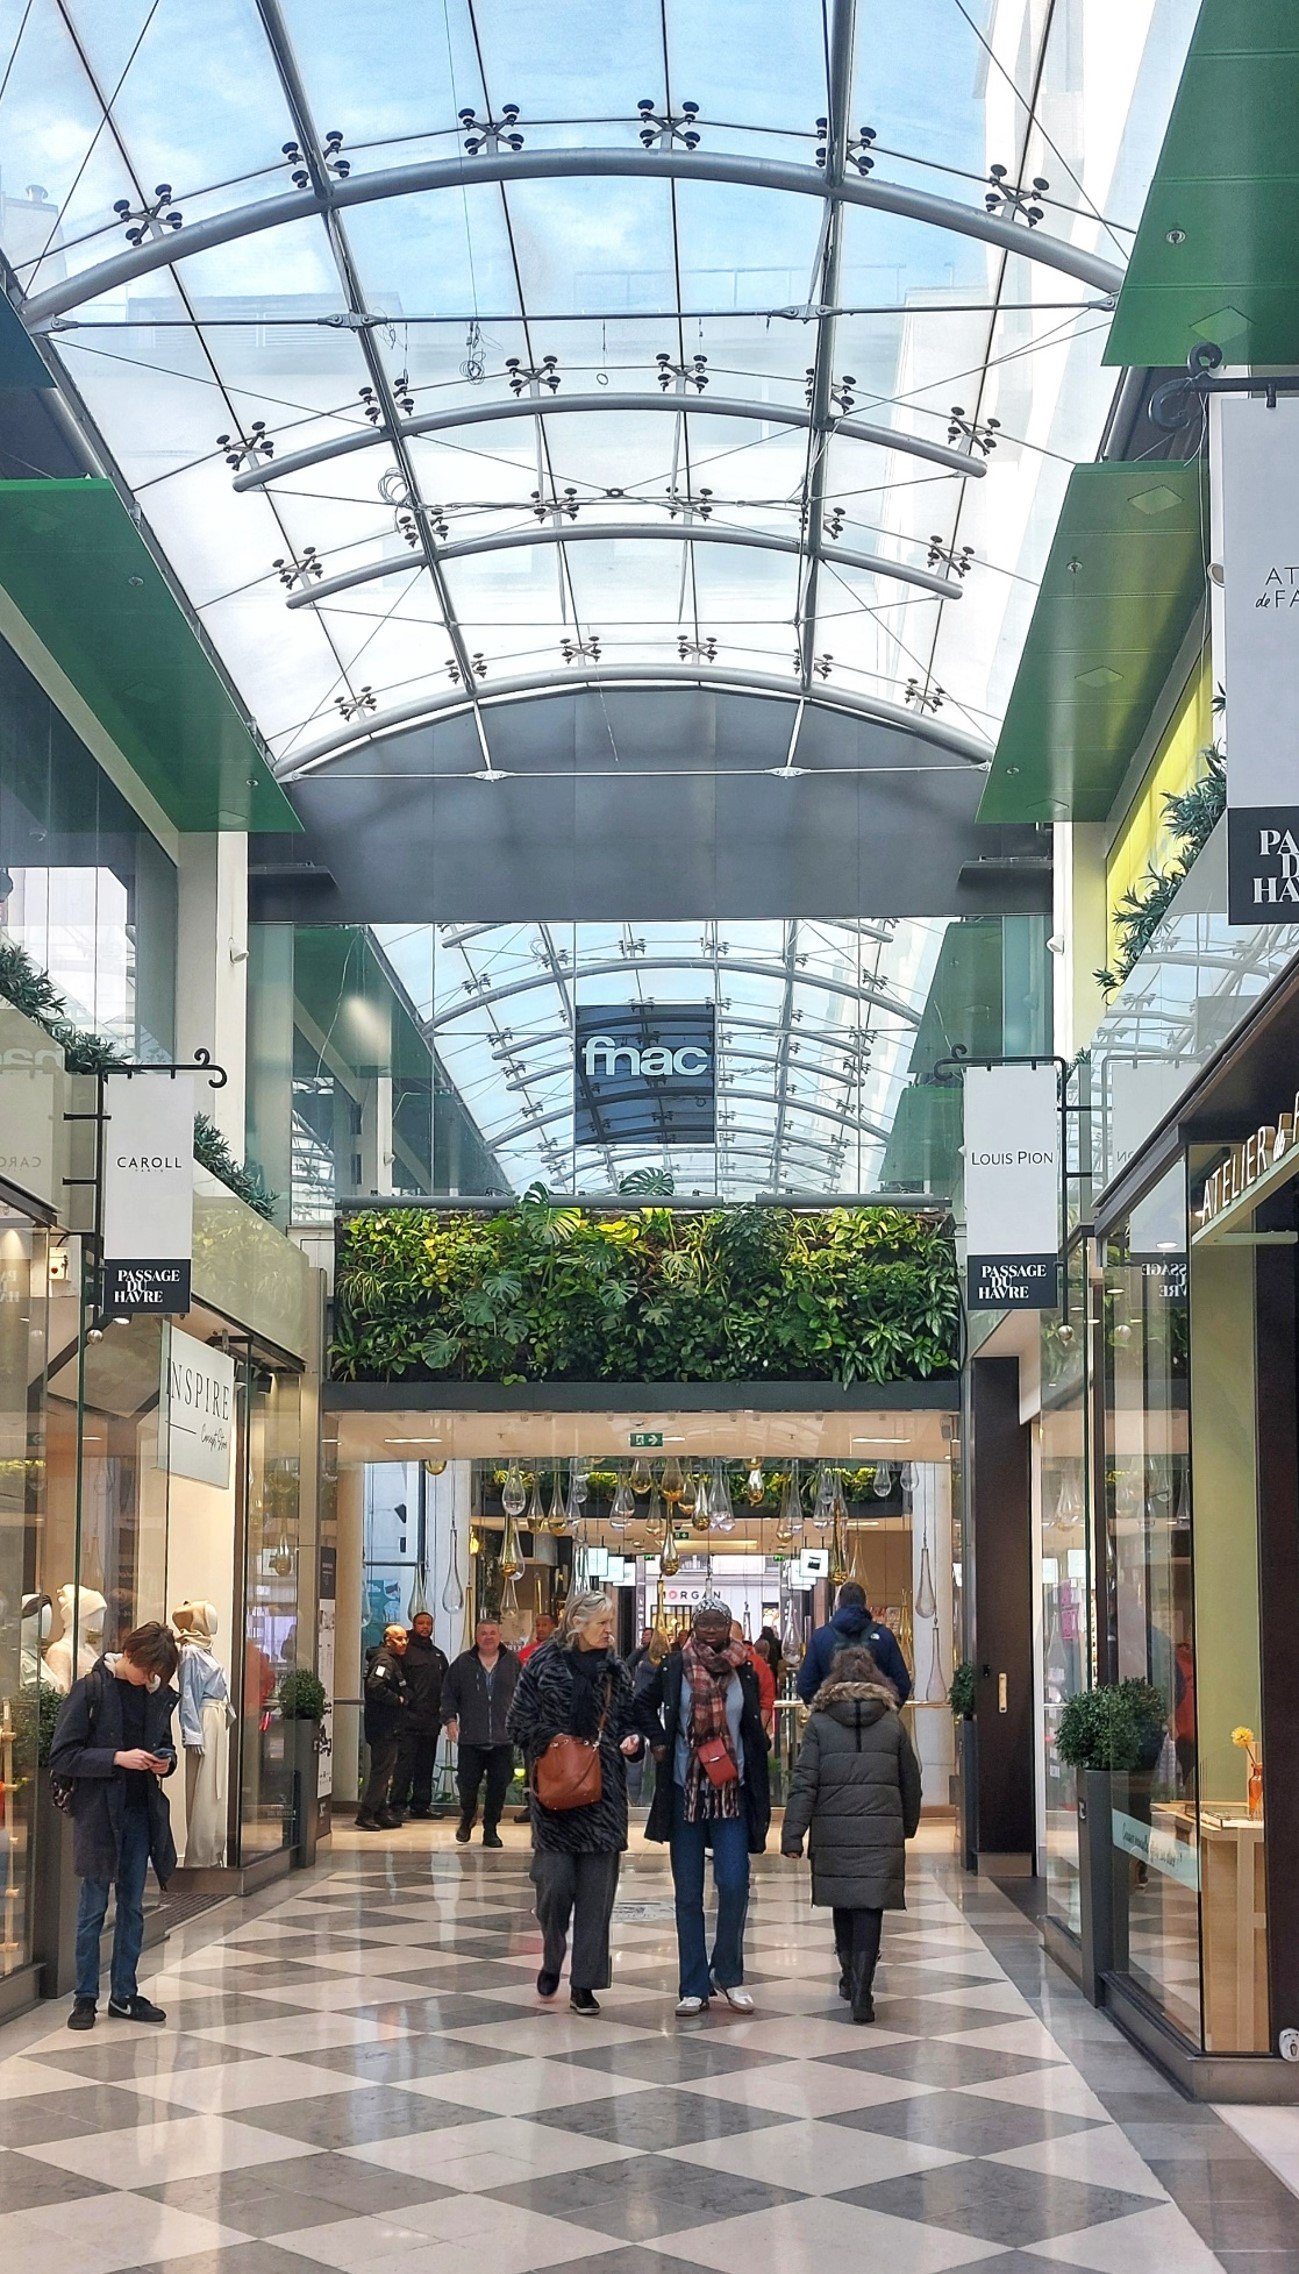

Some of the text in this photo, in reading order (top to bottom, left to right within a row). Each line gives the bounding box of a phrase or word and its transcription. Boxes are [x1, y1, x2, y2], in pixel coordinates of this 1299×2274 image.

[582, 1036, 708, 1076] fnac
[117, 1157, 182, 1168] CAROLL
[971, 1151, 1053, 1165] LOUIS PION
[1201, 1126, 1275, 1226] ATELIER
[117, 1269, 181, 1282] PASSAGE
[981, 1264, 1047, 1278] PASSAGE
[127, 1280, 148, 1292] DU
[991, 1275, 1012, 1289] DU
[114, 1291, 163, 1303] HAVRE
[978, 1286, 1029, 1300] HAVRE
[166, 1358, 230, 1421] INSPIRE
